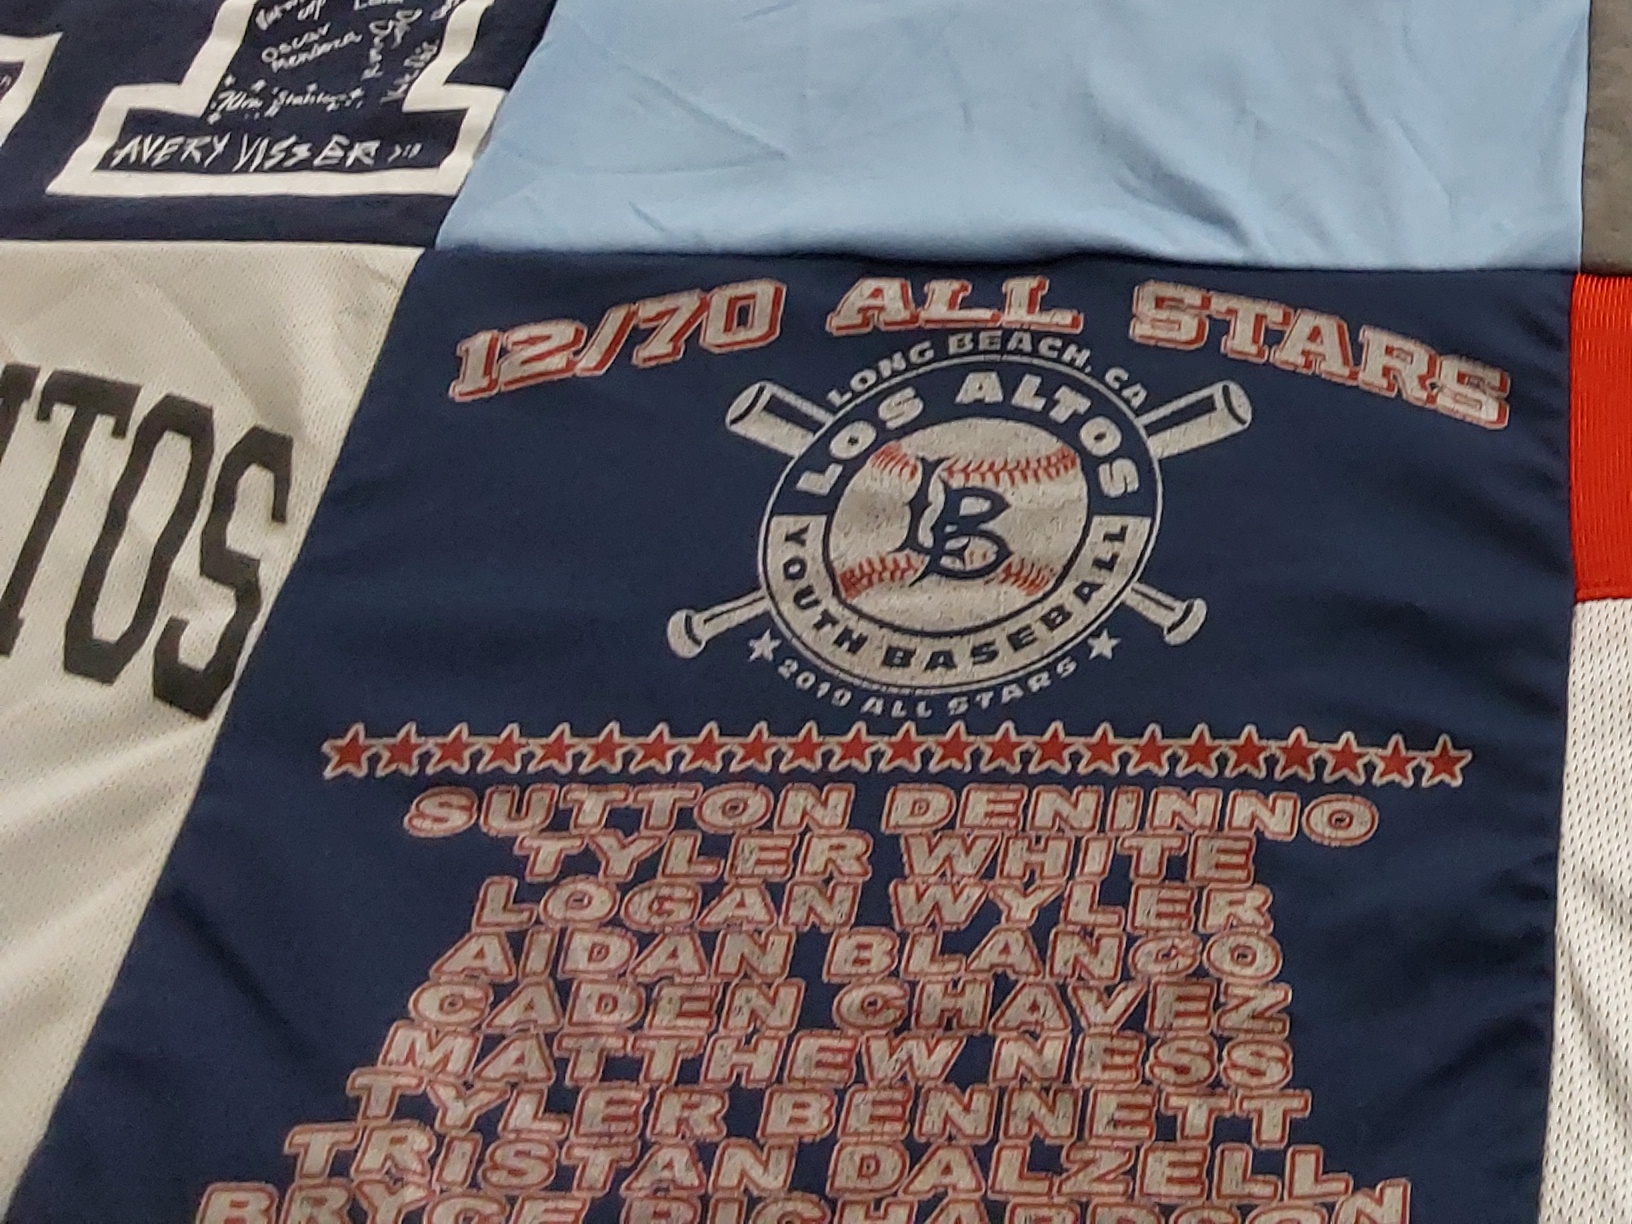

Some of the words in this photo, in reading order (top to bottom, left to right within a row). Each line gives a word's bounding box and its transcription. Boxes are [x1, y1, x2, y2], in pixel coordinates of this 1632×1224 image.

[110, 131, 232, 169] AVERY
[449, 277, 788, 401] 12/70
[826, 275, 1084, 335] ALL
[1131, 279, 1512, 430] STARS
[825, 339, 936, 409] LONG
[947, 330, 1095, 374] BEACH,
[1104, 366, 1149, 409] CA
[795, 386, 926, 497] LOS
[954, 370, 1141, 499] ALTOS
[782, 522, 870, 656] YOUTH
[880, 523, 1131, 672] BASEBALL
[859, 696, 934, 720] ALL
[946, 656, 1080, 718] STARS
[402, 781, 857, 838] SUTTON
[513, 829, 873, 883] TYLER
[900, 830, 1258, 886] WHITE
[472, 875, 860, 933] LOGAN
[889, 878, 1275, 933] WYLER
[429, 925, 796, 982] AIDAN
[823, 923, 1284, 984] BLANCO
[407, 976, 806, 1034] CADEN
[832, 977, 1293, 1038] CHAVEZ
[376, 1018, 970, 1087] MATTHEW
[989, 1031, 1294, 1090] NESS
[347, 1064, 729, 1145] TYLER
[756, 1081, 1313, 1150] BENNETT
[284, 1116, 798, 1198] TRISTAN
[826, 1137, 1356, 1205] DALZELL
